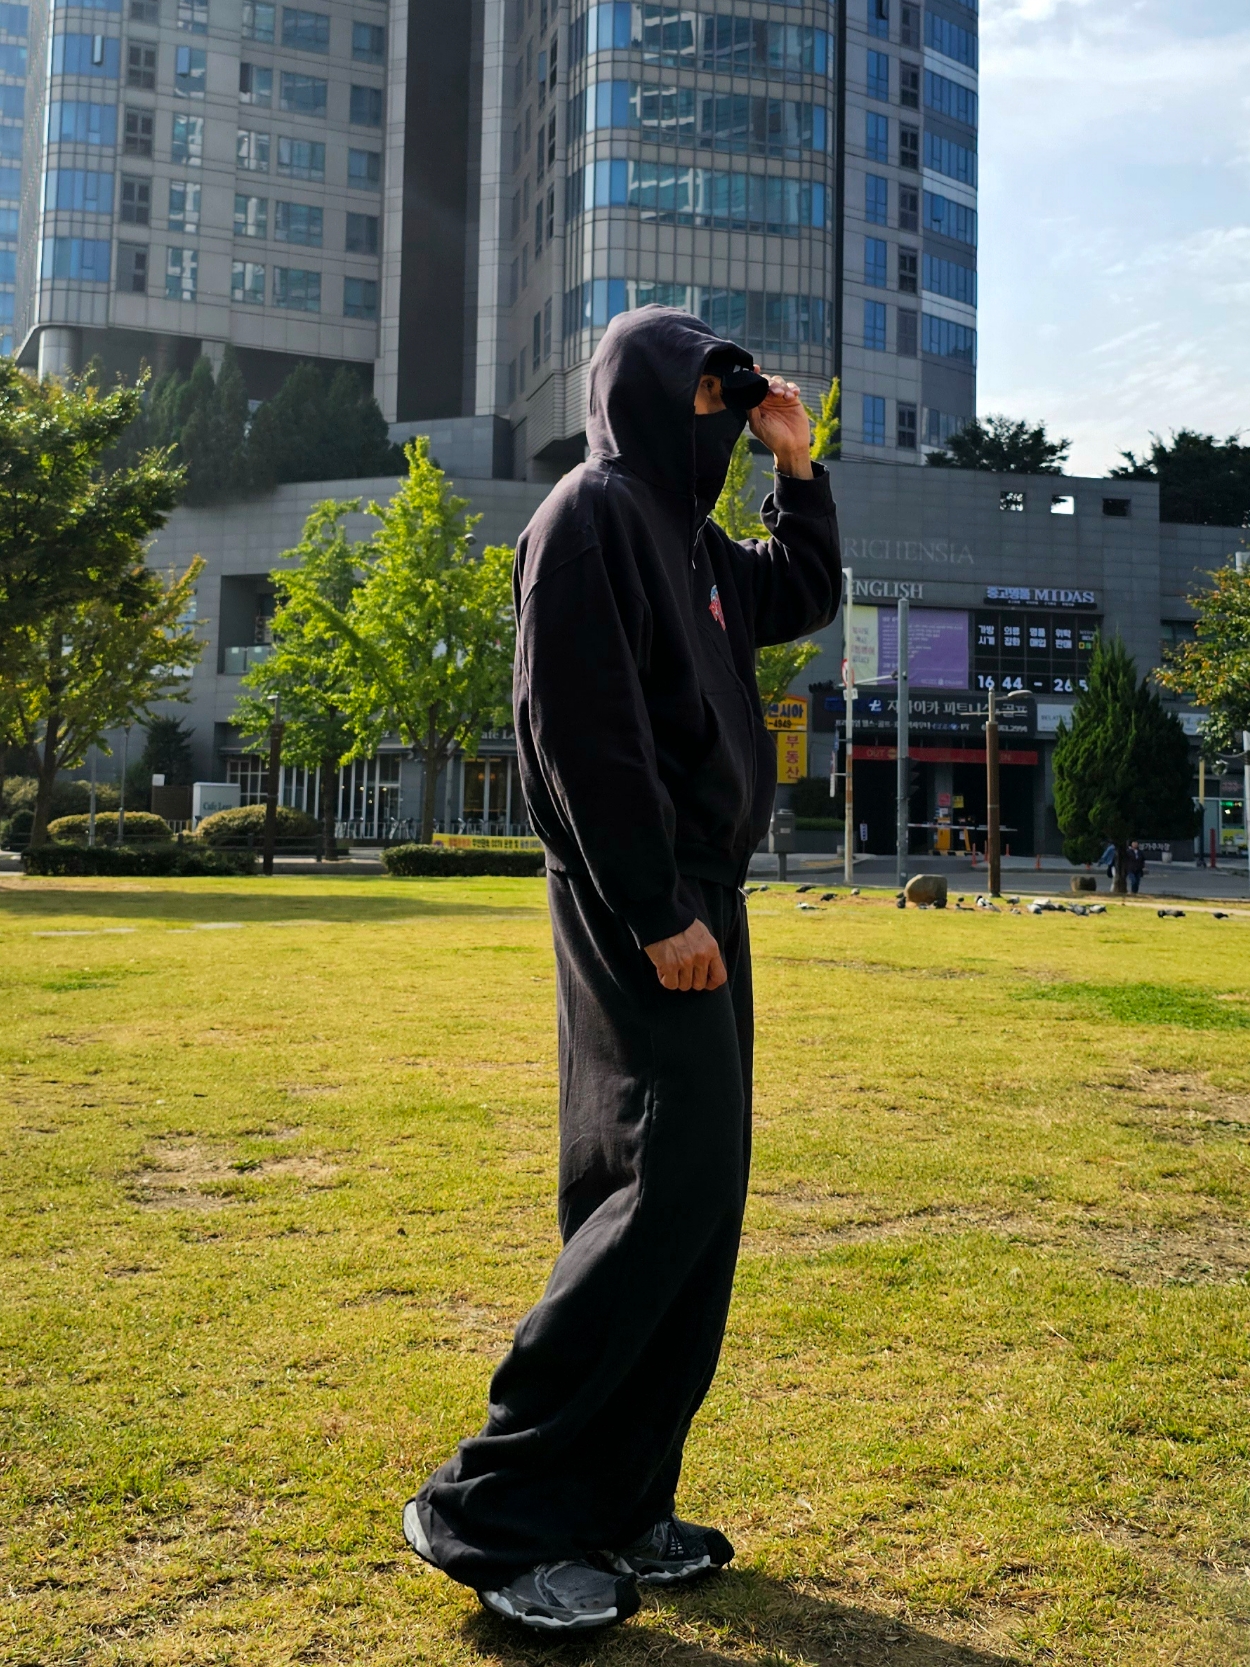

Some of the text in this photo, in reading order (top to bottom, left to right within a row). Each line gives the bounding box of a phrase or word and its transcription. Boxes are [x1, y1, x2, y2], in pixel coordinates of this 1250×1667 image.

[843, 537, 974, 565] RICHENSIA
[1034, 588, 1095, 604] MIDAS
[977, 624, 995, 635] 가방
[785, 735, 800, 779] 부동산
